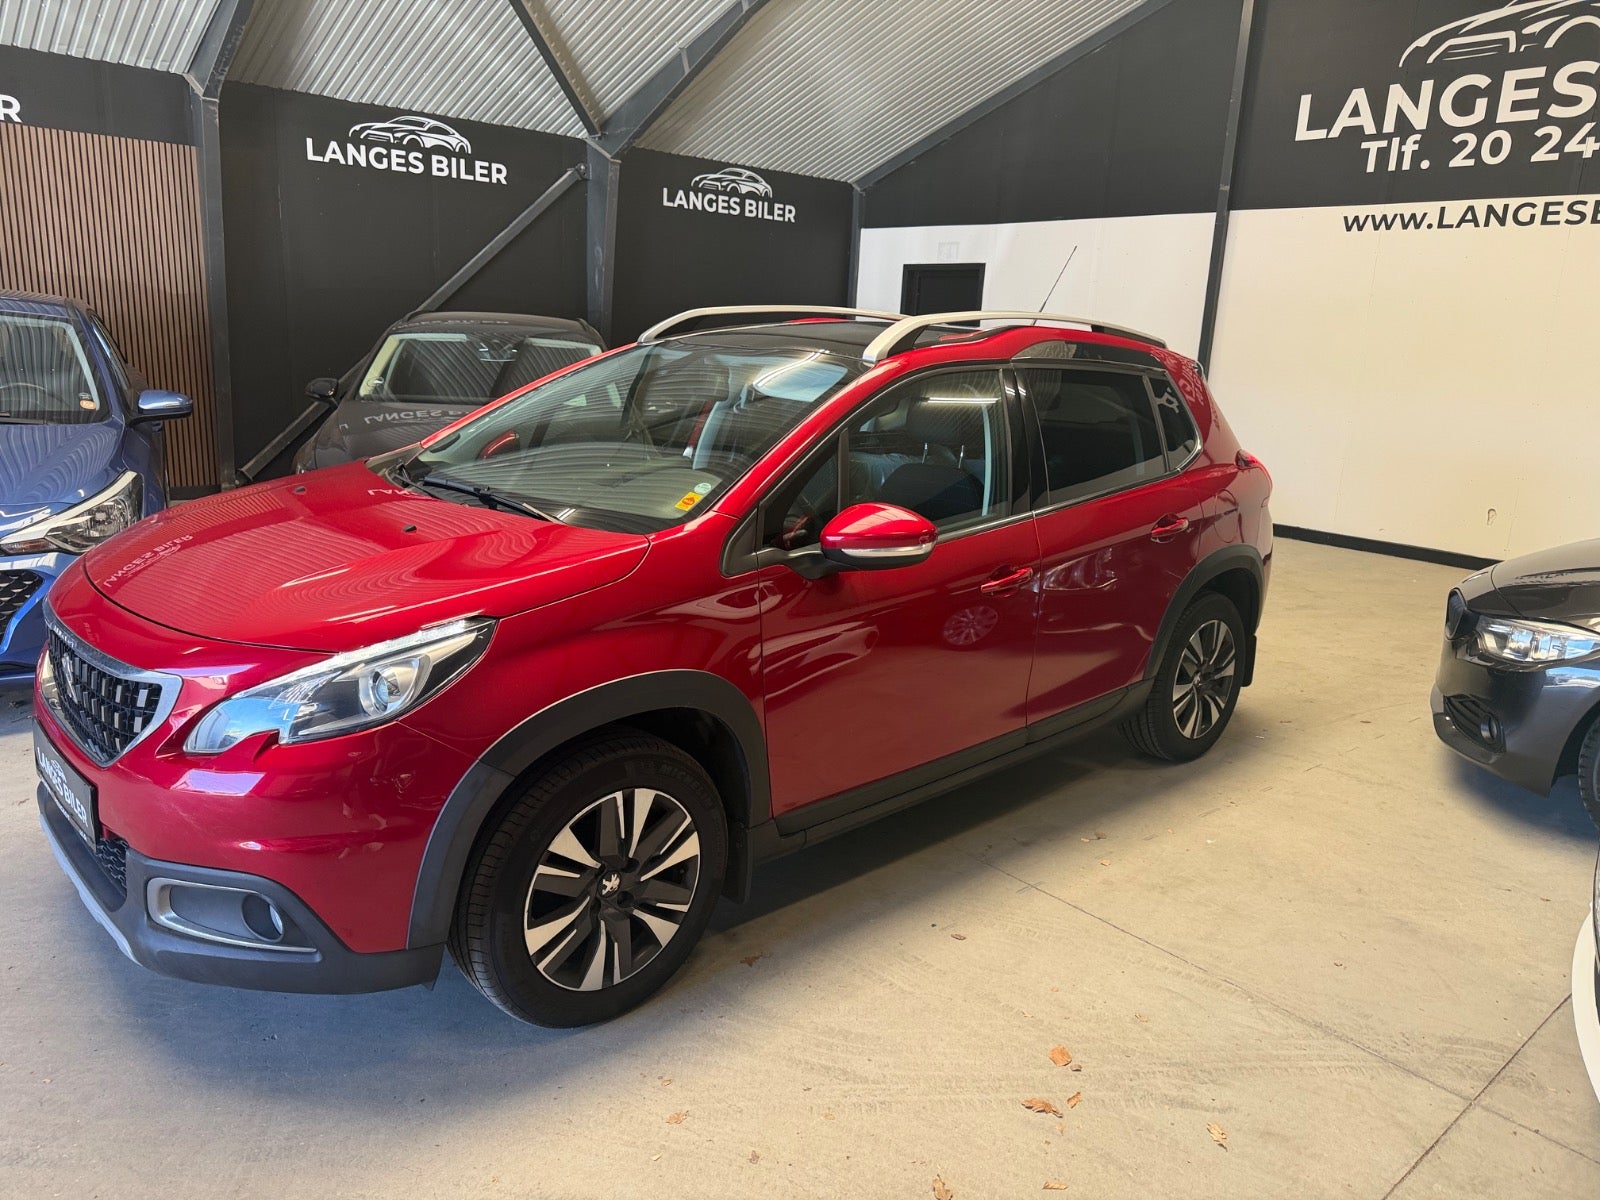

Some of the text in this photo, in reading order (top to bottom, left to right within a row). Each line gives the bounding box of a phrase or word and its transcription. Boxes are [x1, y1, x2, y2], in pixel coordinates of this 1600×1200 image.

[1295, 60, 1600, 142] LANGES
[306, 137, 508, 185] LANGES BILER
[1360, 122, 1600, 173] Tlf. 20 24
[662, 187, 796, 223] LANGES BILER
[63, 782, 89, 828] BILER
